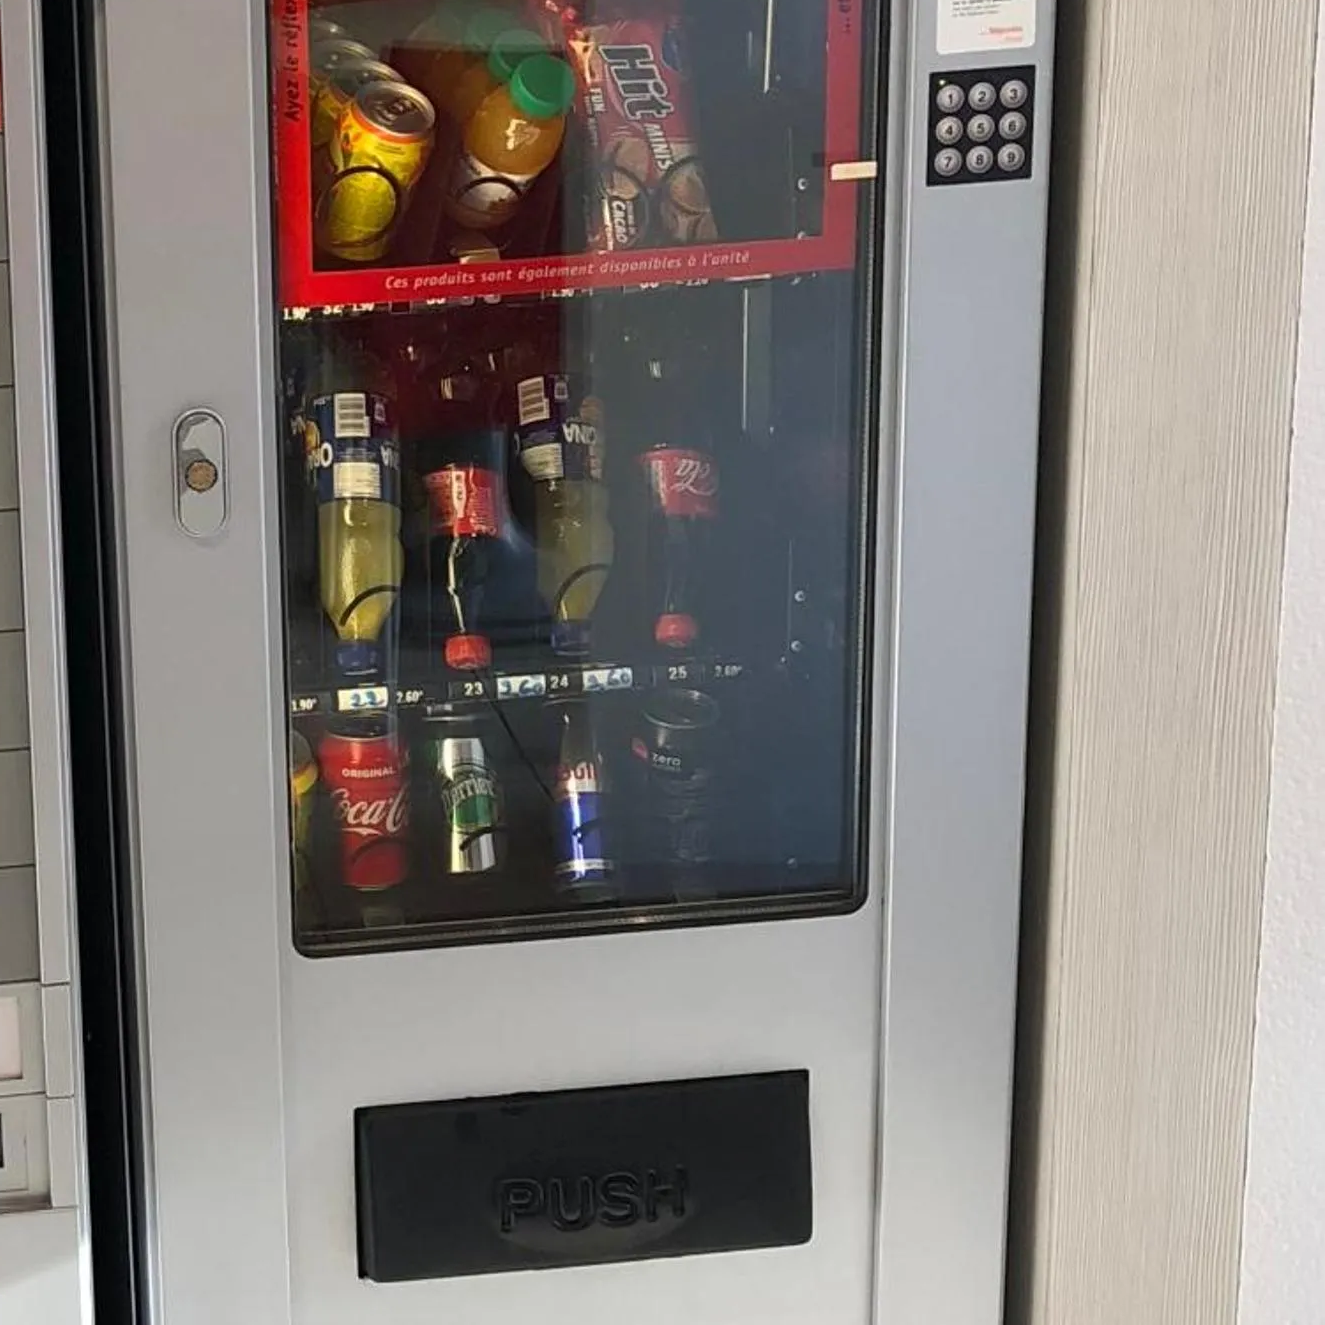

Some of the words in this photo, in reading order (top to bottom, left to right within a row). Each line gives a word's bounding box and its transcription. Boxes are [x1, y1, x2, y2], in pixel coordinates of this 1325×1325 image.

[282, 57, 299, 74] le
[598, 42, 674, 121] Hit
[284, 74, 304, 122] Ayez
[977, 90, 987, 103] 2
[1009, 87, 1018, 101] 3
[945, 124, 954, 136] 4
[976, 122, 985, 135] 5
[1008, 120, 1017, 132] 6
[643, 122, 674, 172] MINIS
[944, 156, 953, 169] 7
[975, 153, 984, 166] 8
[1006, 151, 1016, 164] 9
[384, 275, 409, 290] Ces
[413, 271, 475, 291] produits
[481, 267, 513, 283] sont
[517, 262, 594, 283] également
[597, 257, 682, 275] disponibles
[686, 255, 697, 268] à
[702, 250, 750, 266] l'unité
[667, 665, 688, 681] 25
[463, 681, 484, 696] 23
[550, 674, 569, 689] 24
[651, 752, 682, 767] zero
[341, 766, 397, 779] ORIGINAL
[497, 1163, 690, 1234] PUSH
